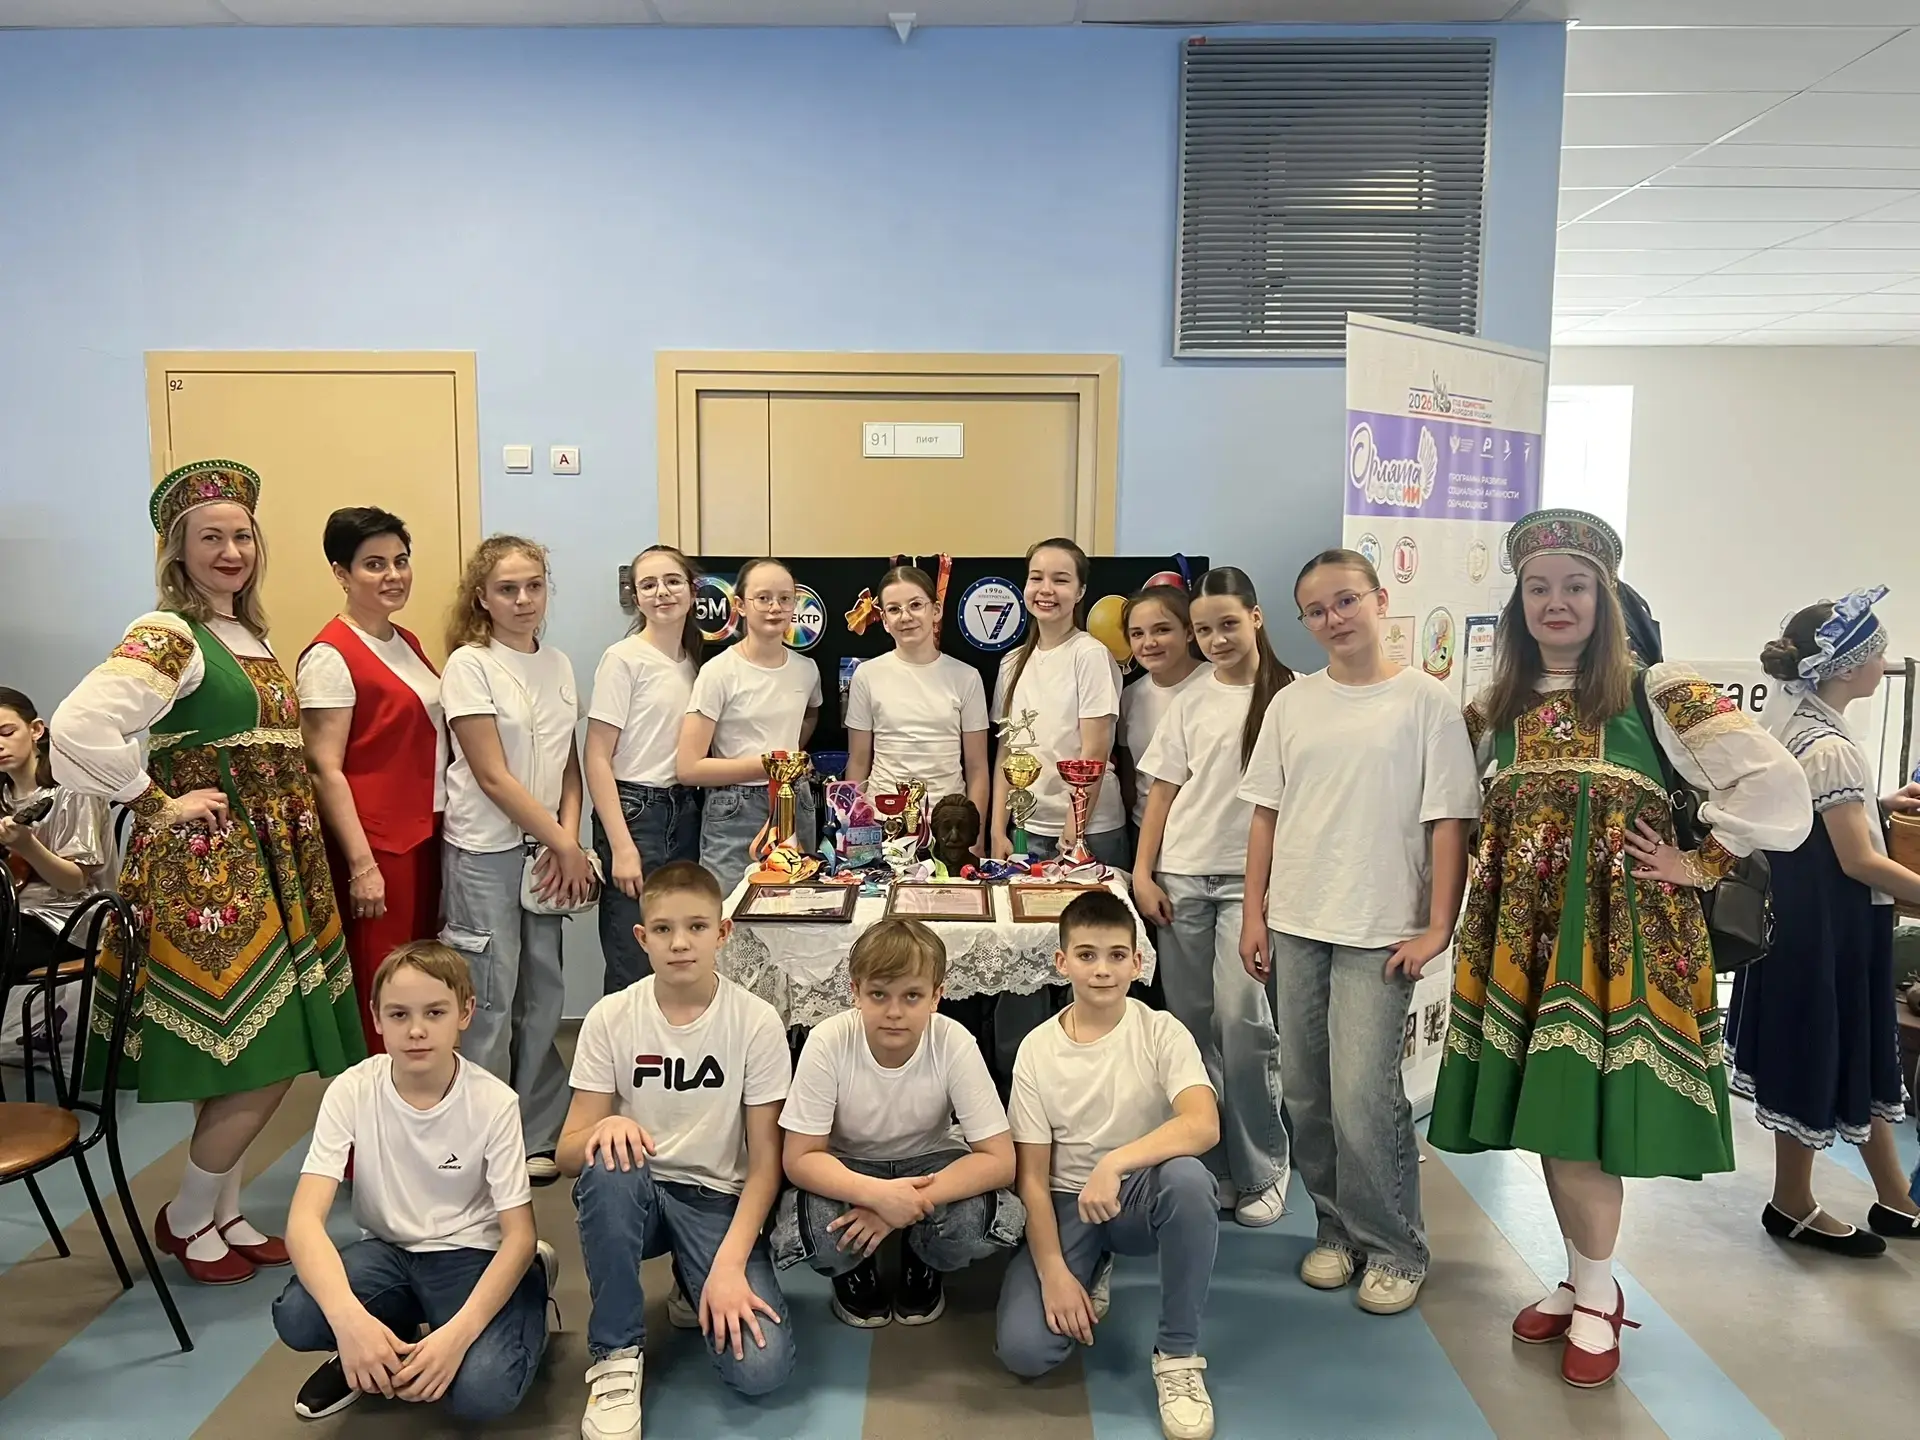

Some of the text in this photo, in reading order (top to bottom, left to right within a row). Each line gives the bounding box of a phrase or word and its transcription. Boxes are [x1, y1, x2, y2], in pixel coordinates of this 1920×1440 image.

[170, 379, 183, 391] 92
[1408, 393, 1432, 411] 2026
[871, 432, 887, 446] 91
[791, 613, 820, 624] ЕКТР
[633, 1055, 724, 1091] FILA
